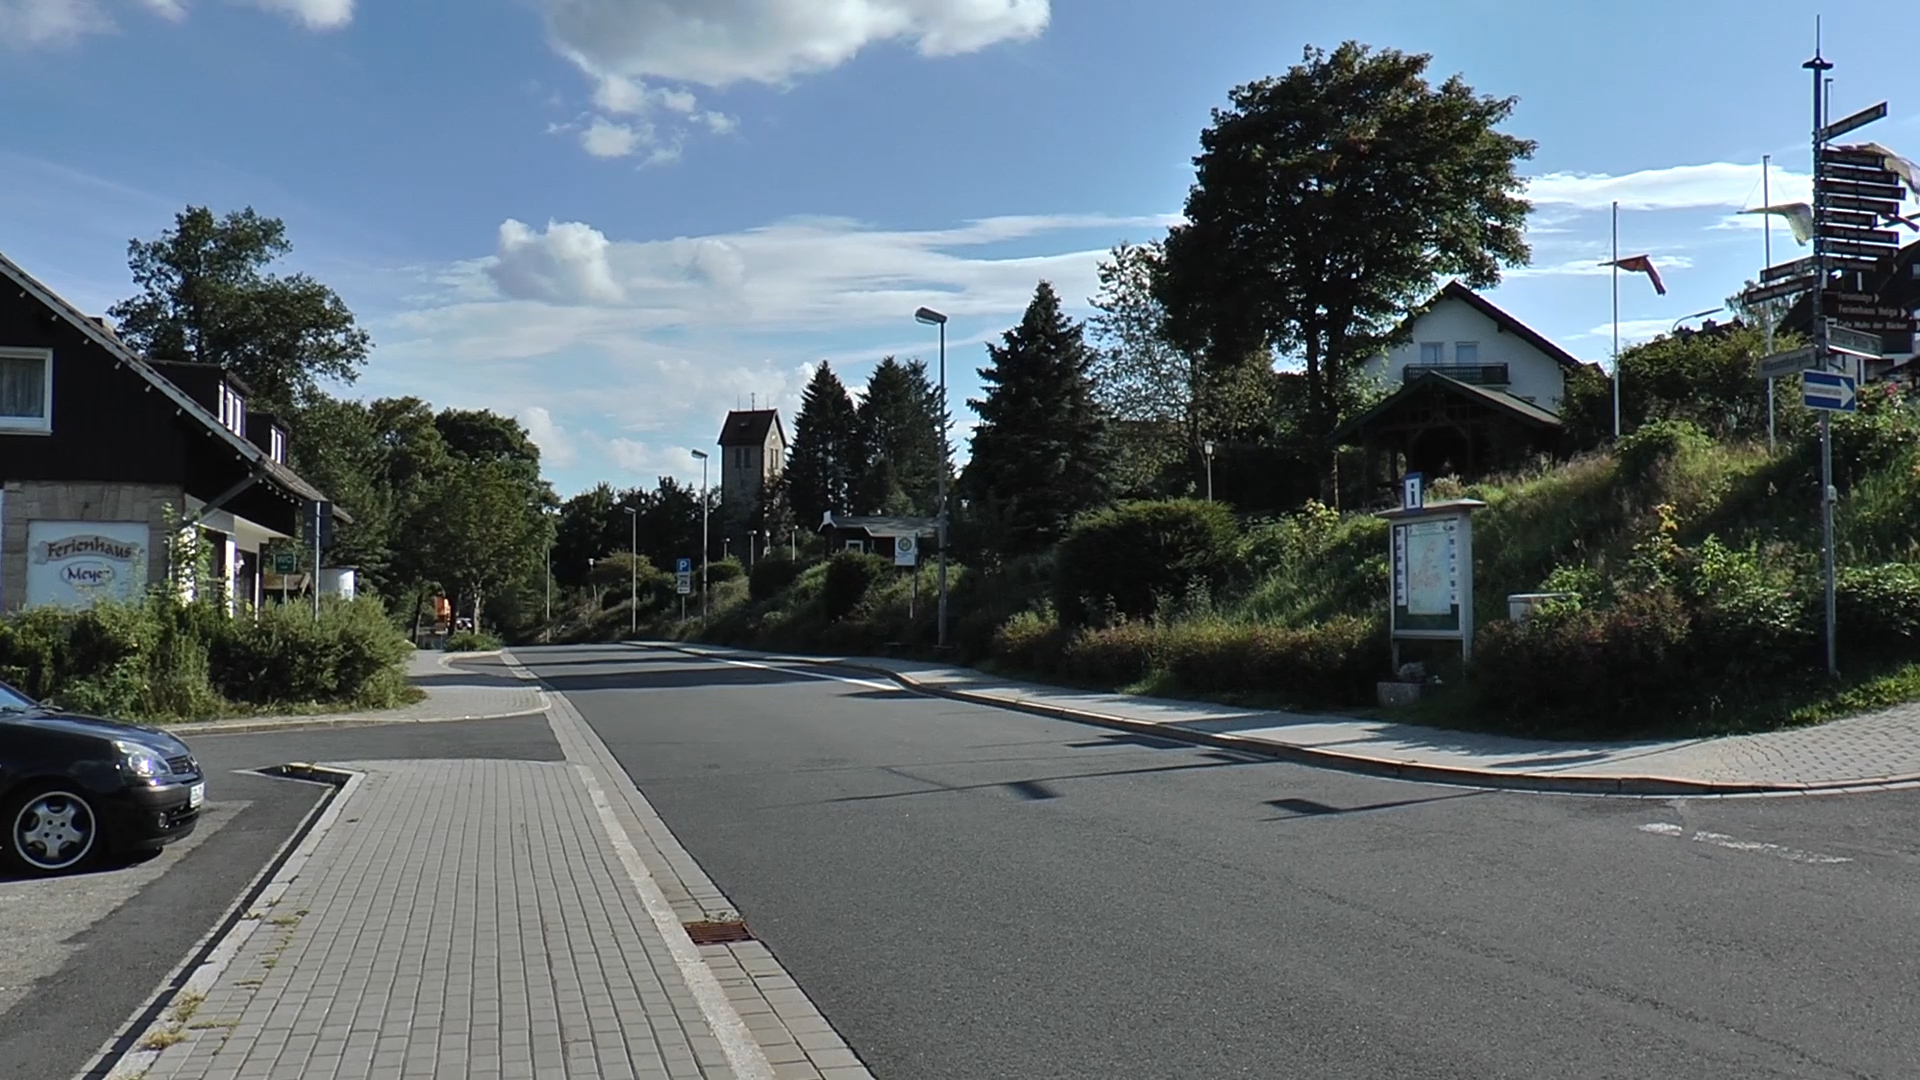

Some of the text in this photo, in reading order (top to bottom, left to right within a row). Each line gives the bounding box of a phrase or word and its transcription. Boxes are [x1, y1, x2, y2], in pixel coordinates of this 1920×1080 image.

[47, 536, 132, 558] Ferienhaus
[276, 555, 293, 564] WC
[679, 560, 688, 571] P
